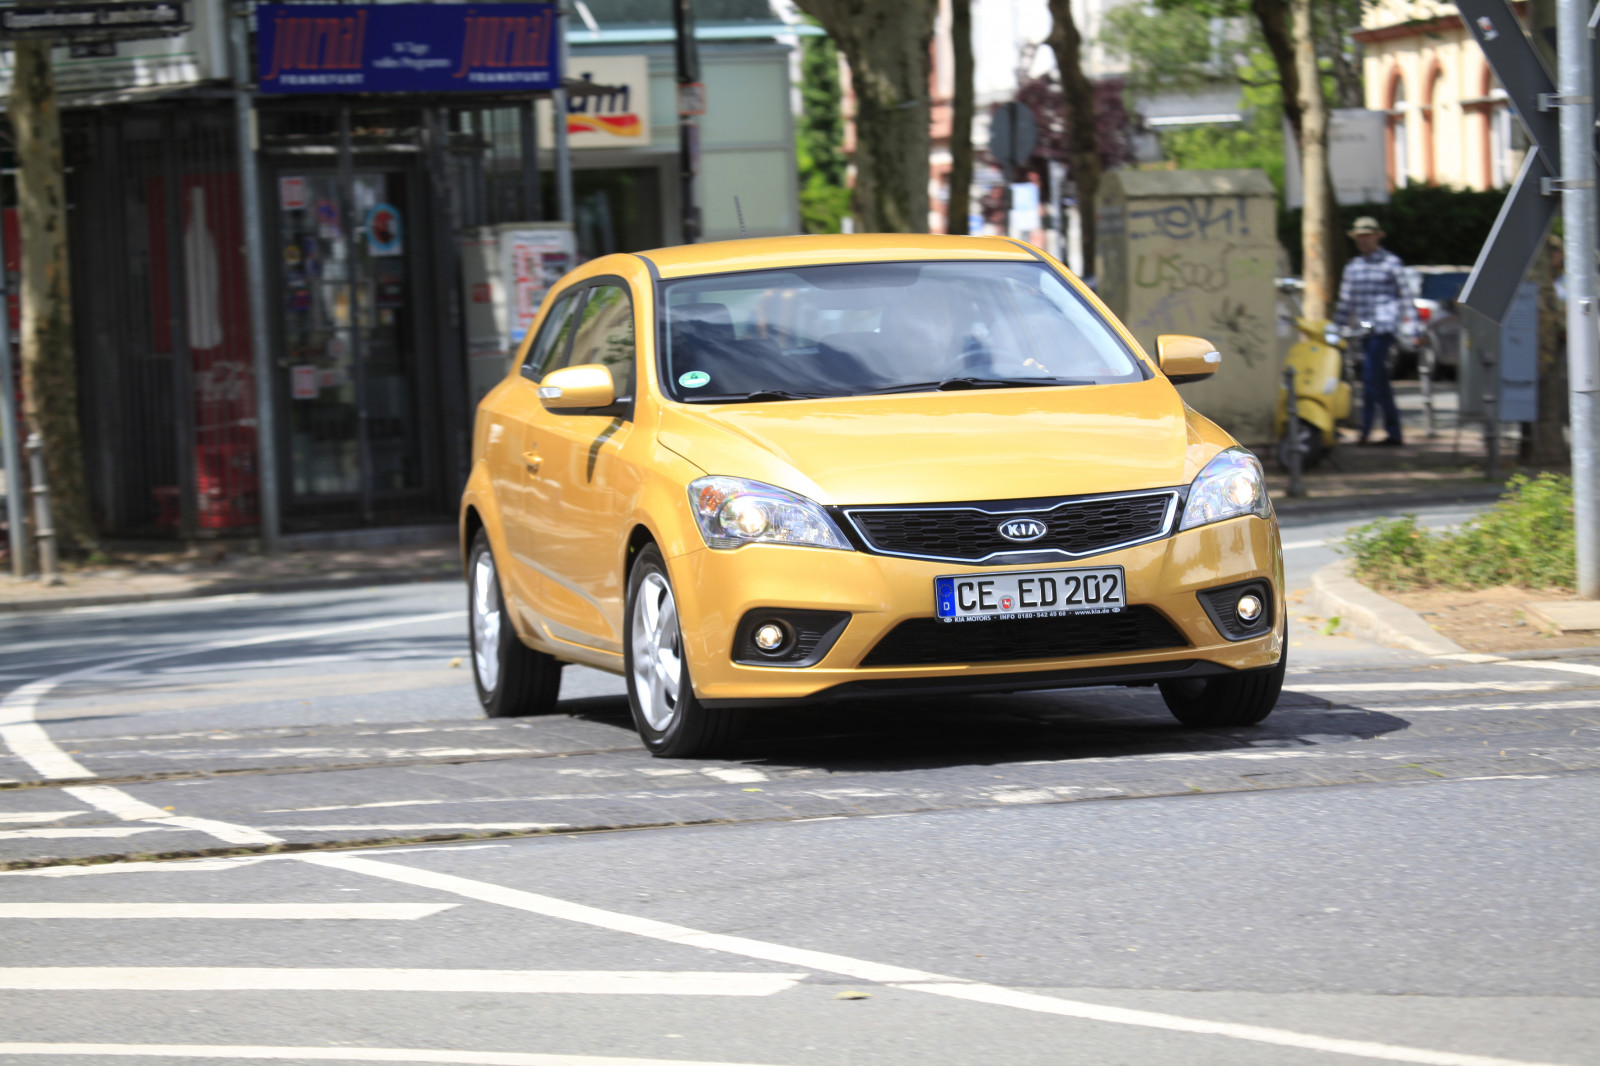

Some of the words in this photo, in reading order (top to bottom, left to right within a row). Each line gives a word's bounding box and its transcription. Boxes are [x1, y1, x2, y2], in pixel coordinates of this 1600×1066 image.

[1007, 523, 1040, 536] KIA
[957, 580, 998, 611] CE
[1018, 577, 1058, 608] ED
[1065, 573, 1120, 605] 202
[943, 601, 951, 611] D
[1074, 608, 1110, 616] www.kia.de
